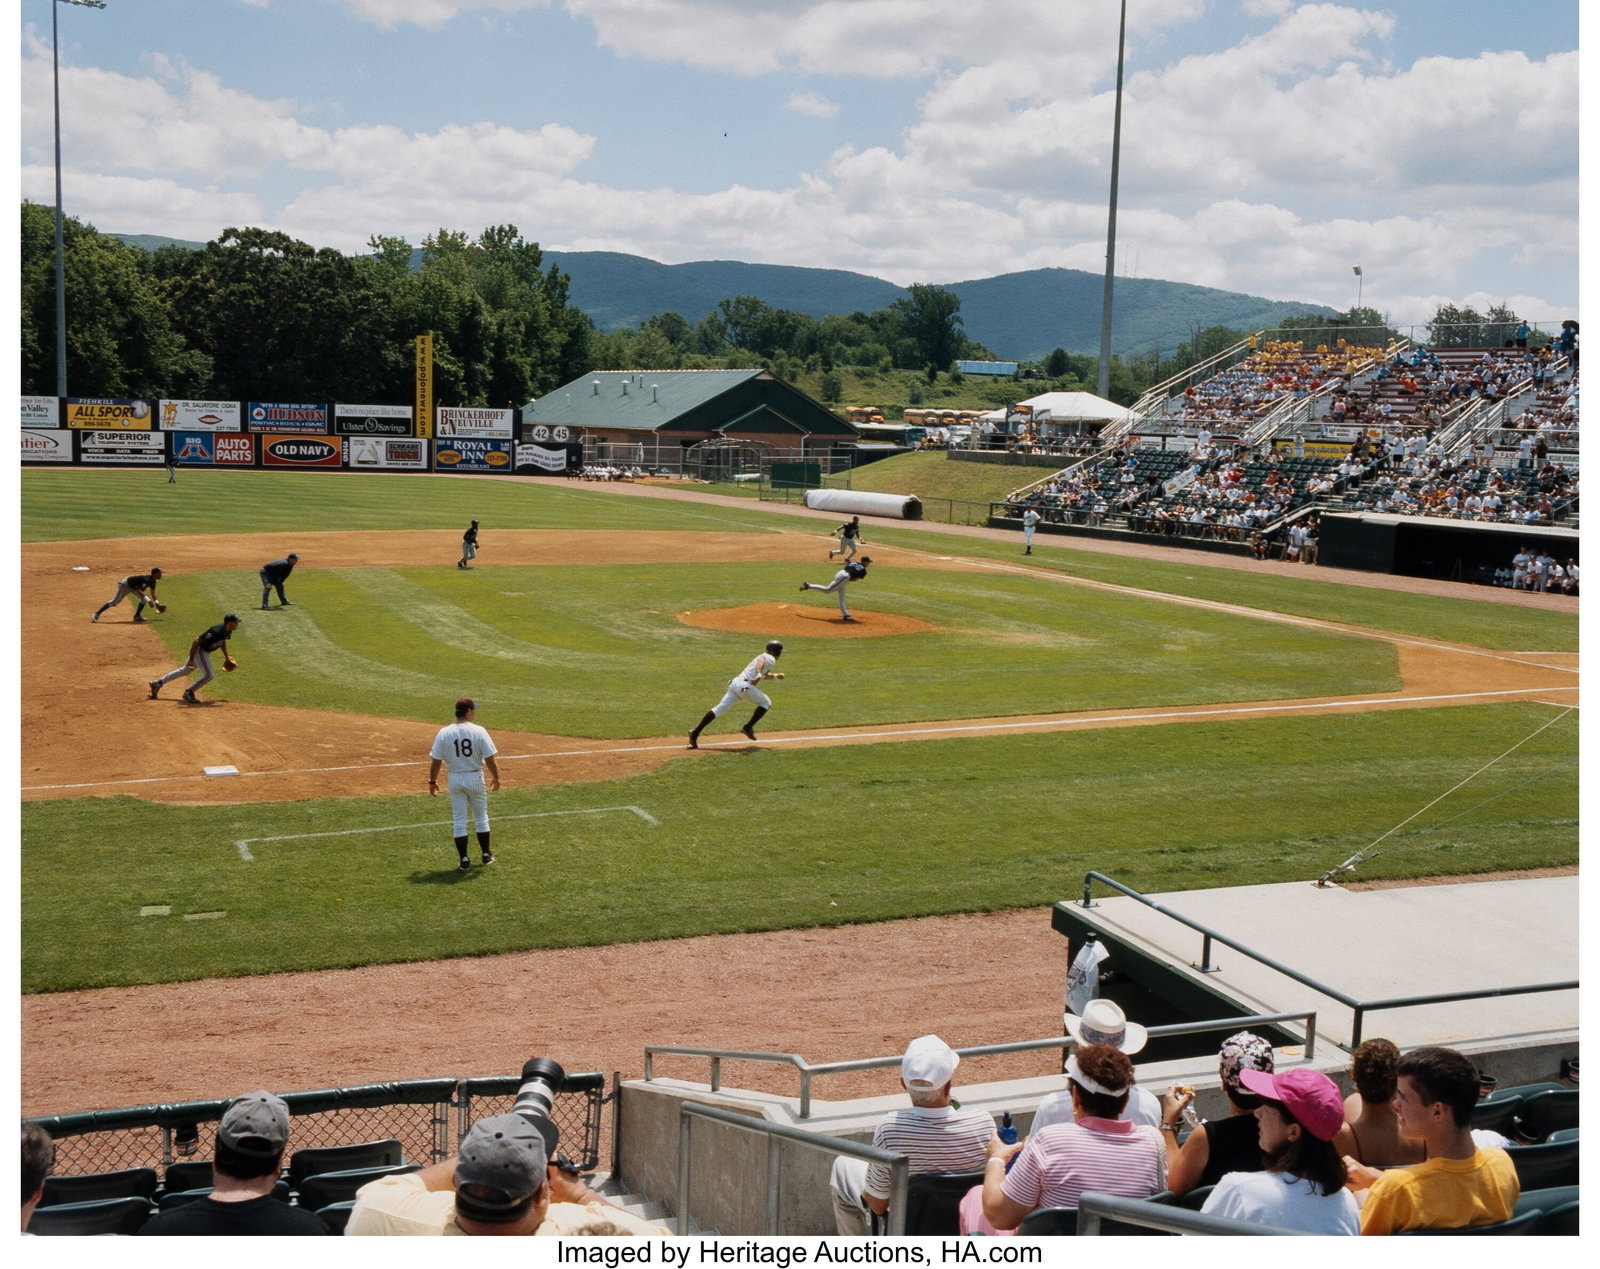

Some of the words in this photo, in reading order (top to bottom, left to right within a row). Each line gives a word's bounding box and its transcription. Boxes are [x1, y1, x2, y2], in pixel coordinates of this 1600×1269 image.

[419, 338, 427, 436] www.pojonews.com
[27, 405, 48, 414] Valley
[75, 407, 95, 417] ALL
[97, 407, 136, 417] SPORT
[268, 408, 324, 421] HUDSON
[440, 410, 505, 425] BRINCKERHOFF
[378, 423, 406, 433] Savings
[440, 426, 447, 435] &
[448, 420, 494, 434] NEUVILLE
[535, 429, 546, 438] 42
[556, 430, 567, 439] 45
[21, 438, 49, 448] ntier
[217, 439, 249, 449] AUTO
[453, 440, 493, 450] ROYAL
[216, 450, 251, 460] PARTS
[275, 445, 297, 455] OLD
[299, 446, 329, 455] NAVY
[462, 450, 484, 459] INN
[454, 738, 472, 757] 18
